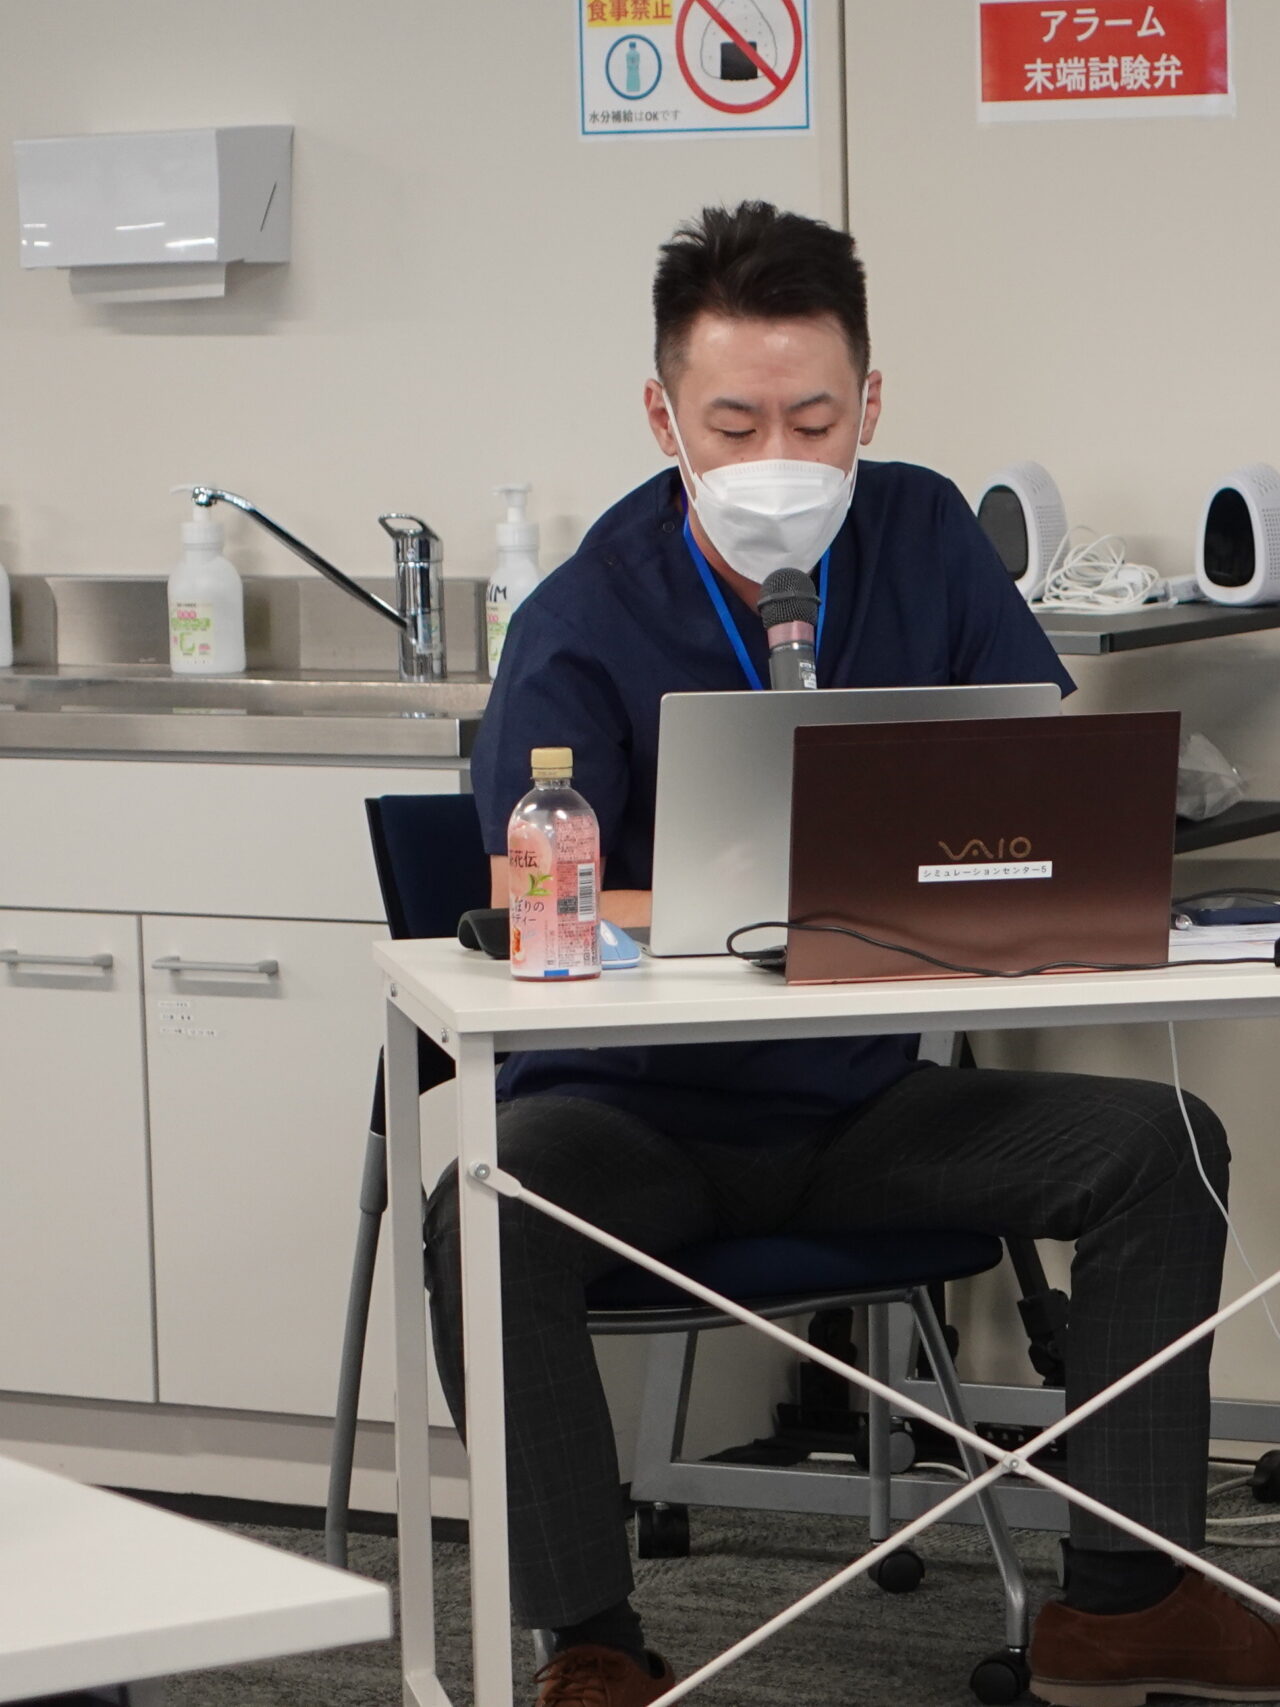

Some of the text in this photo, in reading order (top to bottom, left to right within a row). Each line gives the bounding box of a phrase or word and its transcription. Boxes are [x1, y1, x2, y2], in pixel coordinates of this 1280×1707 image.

[588, 0, 672, 22] 食事禁止
[1040, 5, 1166, 43] アラーム
[1024, 53, 1183, 93] 末端試験弁
[588, 109, 681, 124] 水分補給はOKです
[938, 836, 1032, 861] VAIO
[923, 865, 1048, 878] シミュレーションセンター5
